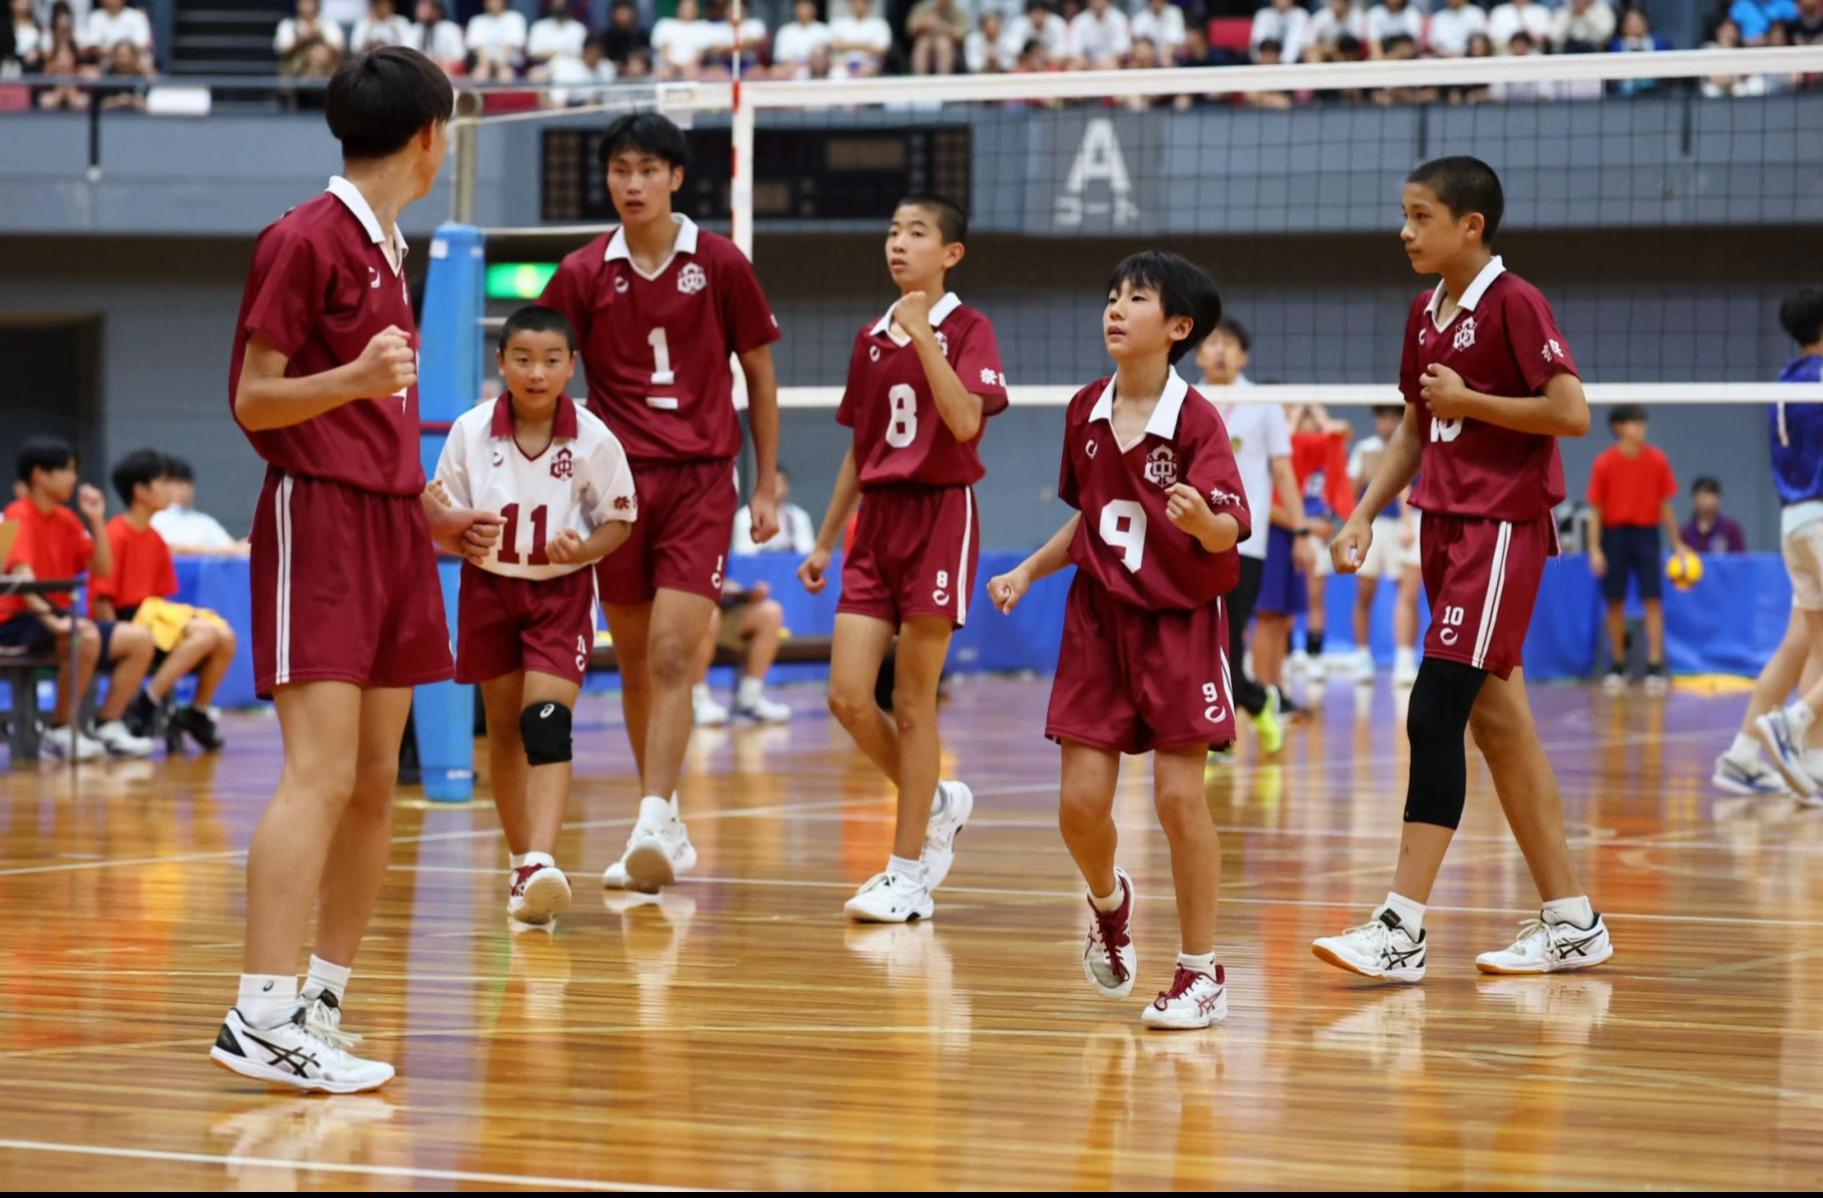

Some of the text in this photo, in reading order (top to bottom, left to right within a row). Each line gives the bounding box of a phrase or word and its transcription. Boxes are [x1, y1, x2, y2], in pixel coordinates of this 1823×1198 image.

[1066, 118, 1131, 193] A
[647, 327, 675, 385] 1
[885, 383, 918, 449] 8
[497, 502, 550, 566] 11
[1099, 499, 1148, 574] 9
[936, 569, 949, 589] 8
[1442, 605, 1465, 627] 10
[1202, 681, 1218, 703] 9
